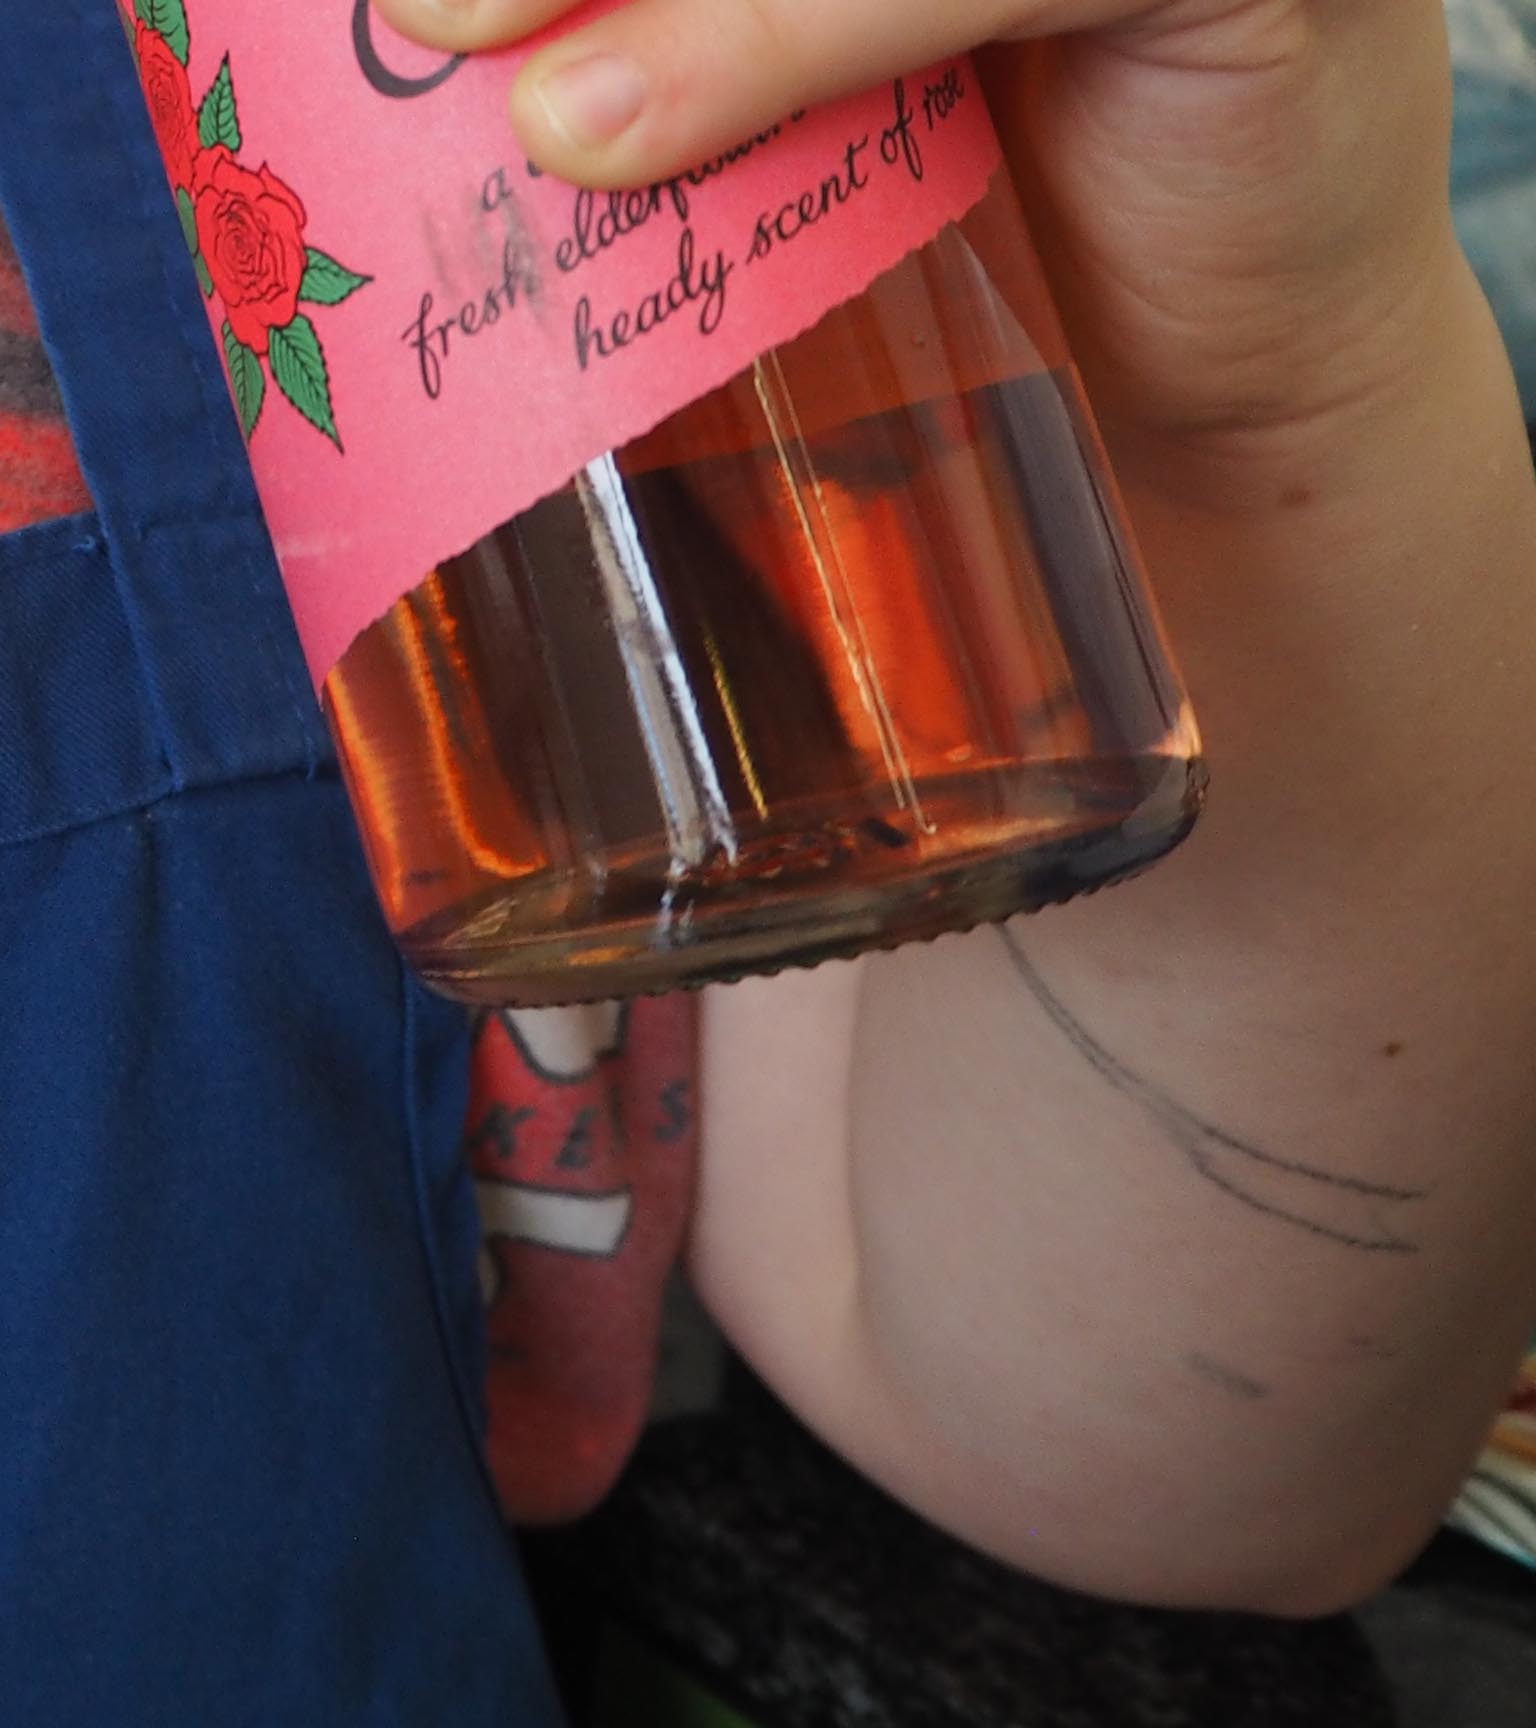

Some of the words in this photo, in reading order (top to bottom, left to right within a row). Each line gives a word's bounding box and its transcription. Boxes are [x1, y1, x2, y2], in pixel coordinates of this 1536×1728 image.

[400, 240, 544, 399] fresh
[573, 226, 734, 371] heady
[745, 135, 868, 266] scent
[880, 76, 923, 184] of
